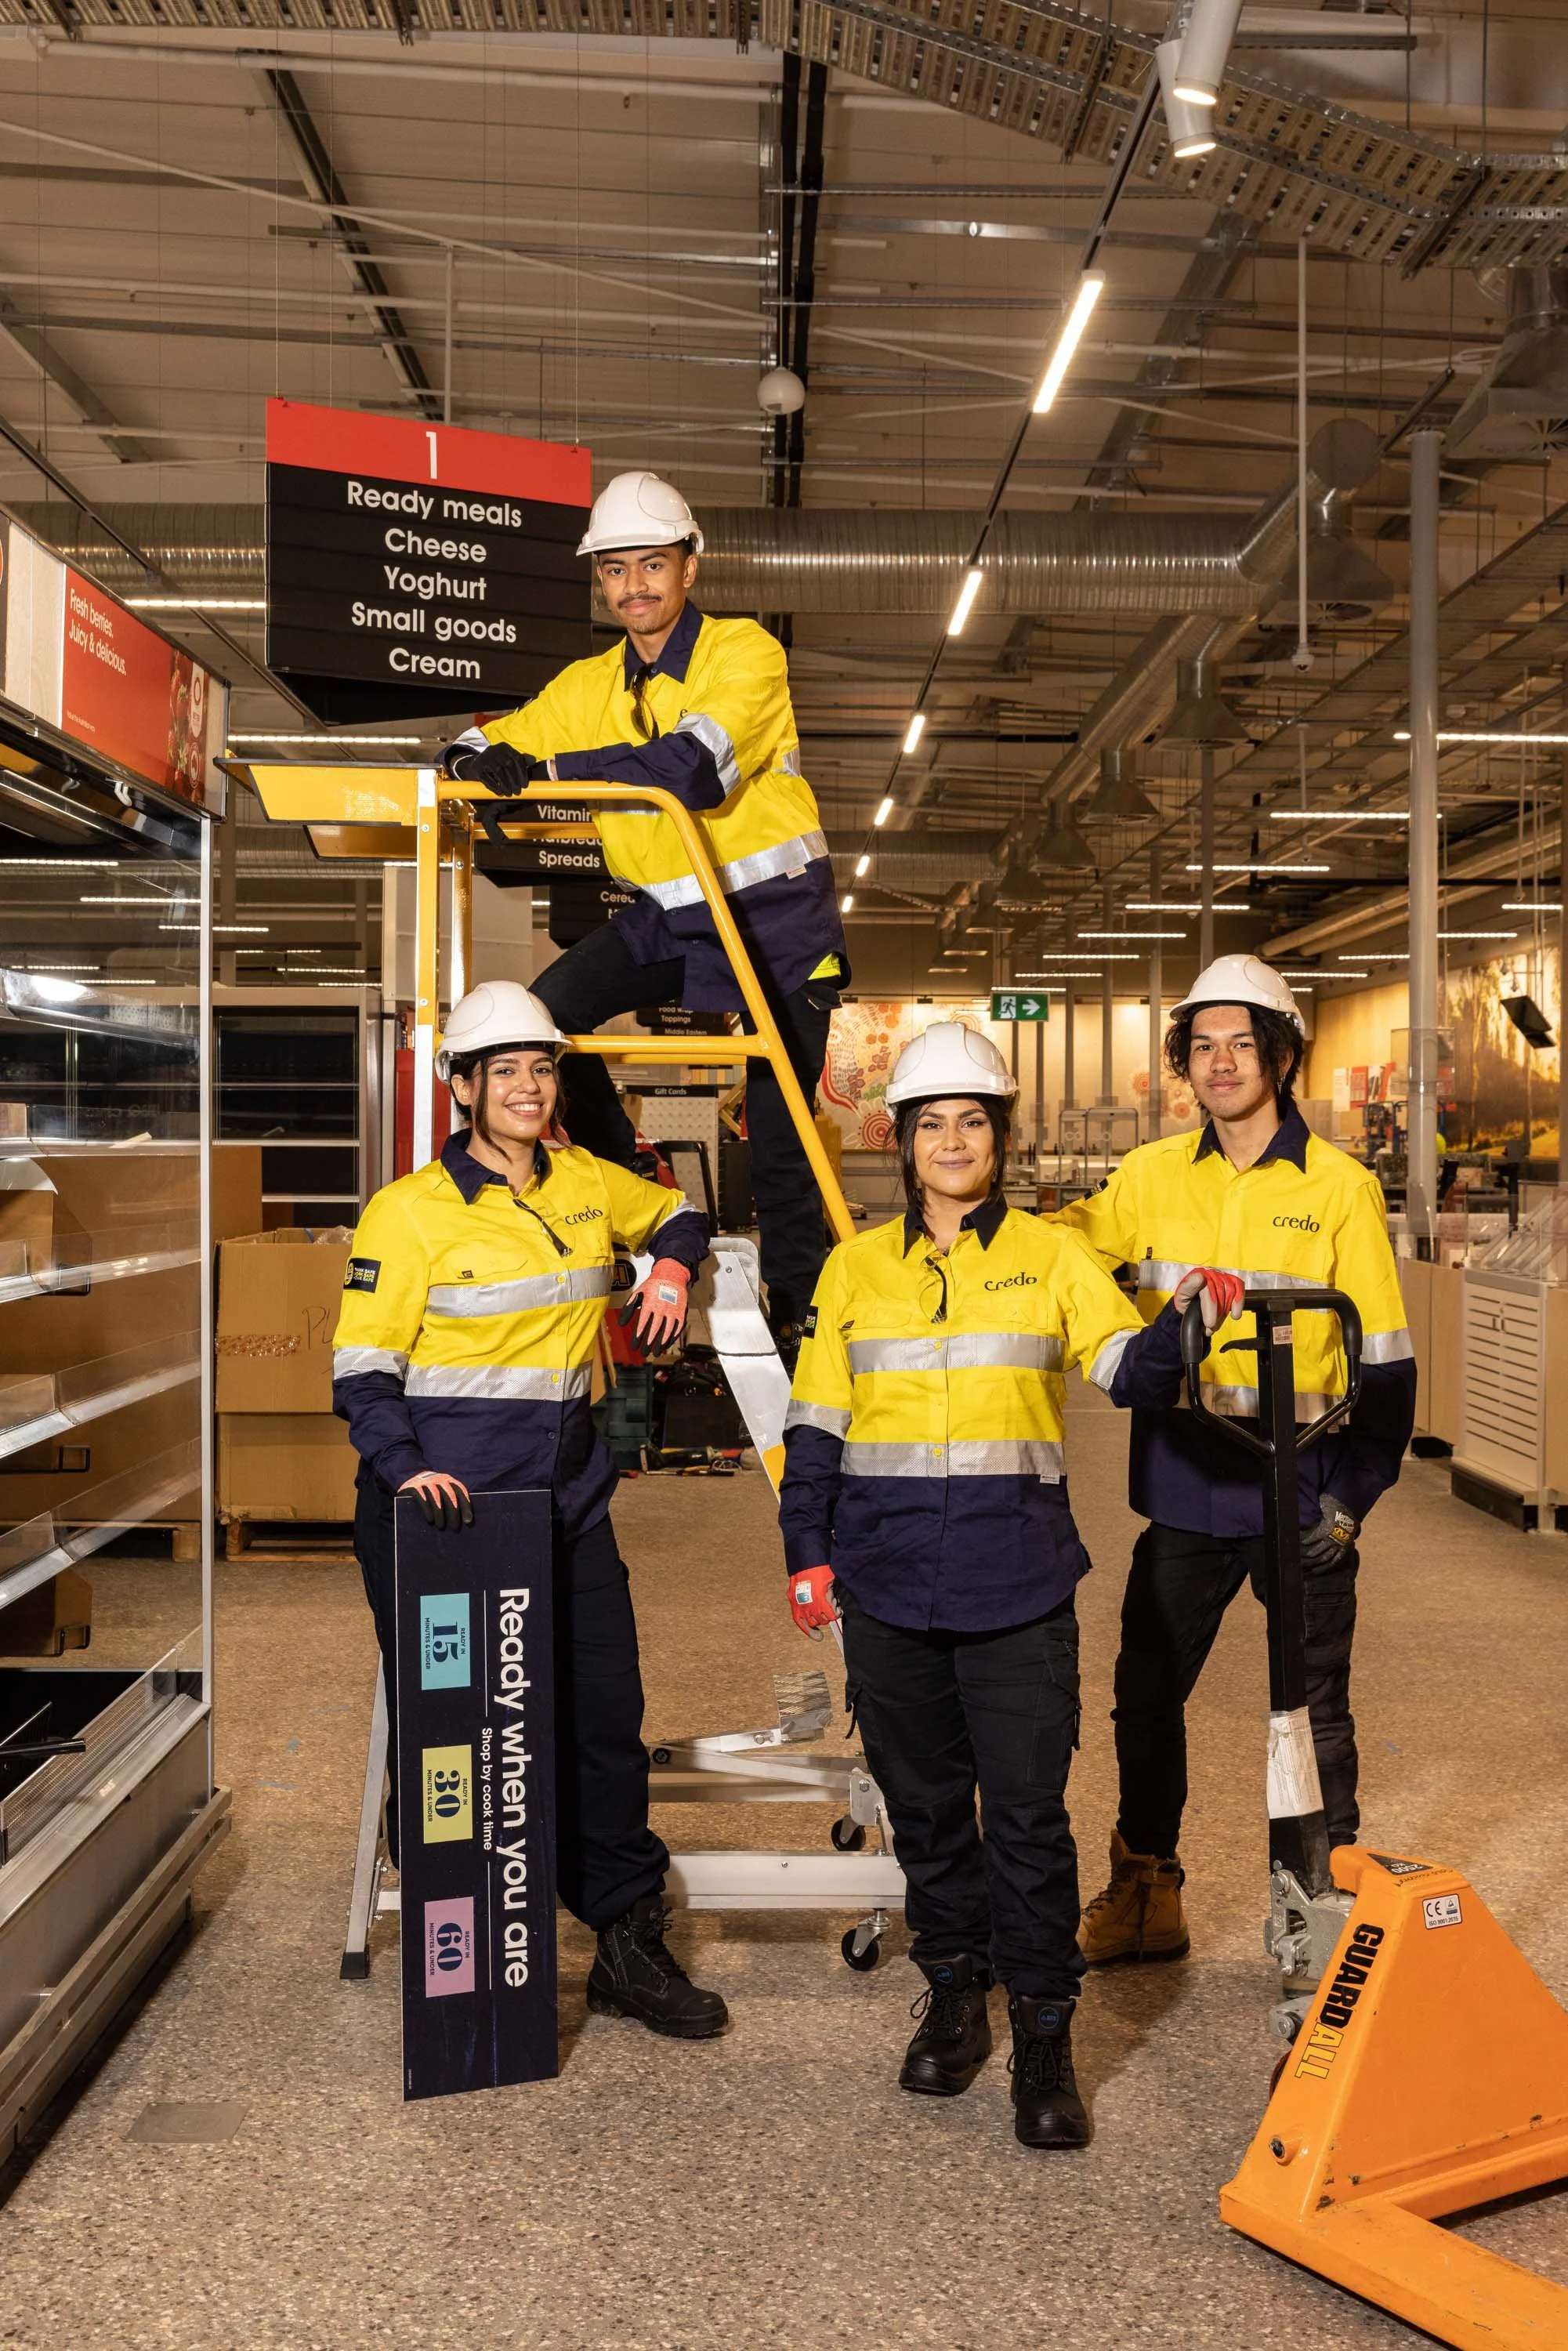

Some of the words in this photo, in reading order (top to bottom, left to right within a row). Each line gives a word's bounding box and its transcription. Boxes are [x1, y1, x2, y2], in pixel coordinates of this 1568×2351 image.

[425, 431, 438, 480] 1
[347, 481, 434, 520] Ready
[443, 498, 522, 527] meals
[385, 528, 487, 563] Cheese
[384, 565, 487, 600] Yoghurt
[70, 588, 89, 620] Fresh
[90, 601, 114, 639] berries.
[352, 602, 425, 632] Small
[435, 616, 516, 643] goods
[69, 619, 88, 654] Juicy
[89, 632, 95, 654] &
[96, 639, 126, 676] delicious.
[389, 647, 481, 679] Cream
[538, 850, 600, 868] Spreads
[661, 1015, 691, 1024] Toppings
[564, 1205, 603, 1226] credo
[1272, 1214, 1320, 1233] credo
[984, 1271, 1037, 1291] credo
[433, 1621, 458, 1662] 15
[494, 1588, 531, 1711] Ready
[480, 1727, 493, 1762] Shop
[480, 1765, 493, 1781] by
[502, 1720, 532, 1828] when
[434, 1770, 461, 1818] 30
[483, 1784, 494, 1818] cook
[483, 1821, 494, 1850] time
[496, 1838, 528, 1911] you
[1391, 1864, 1423, 1874] 2500
[1425, 1901, 1442, 1917] CE
[436, 1922, 462, 1972] 60
[504, 1922, 529, 1987] are
[1295, 1923, 1385, 2079] GUARDALL
